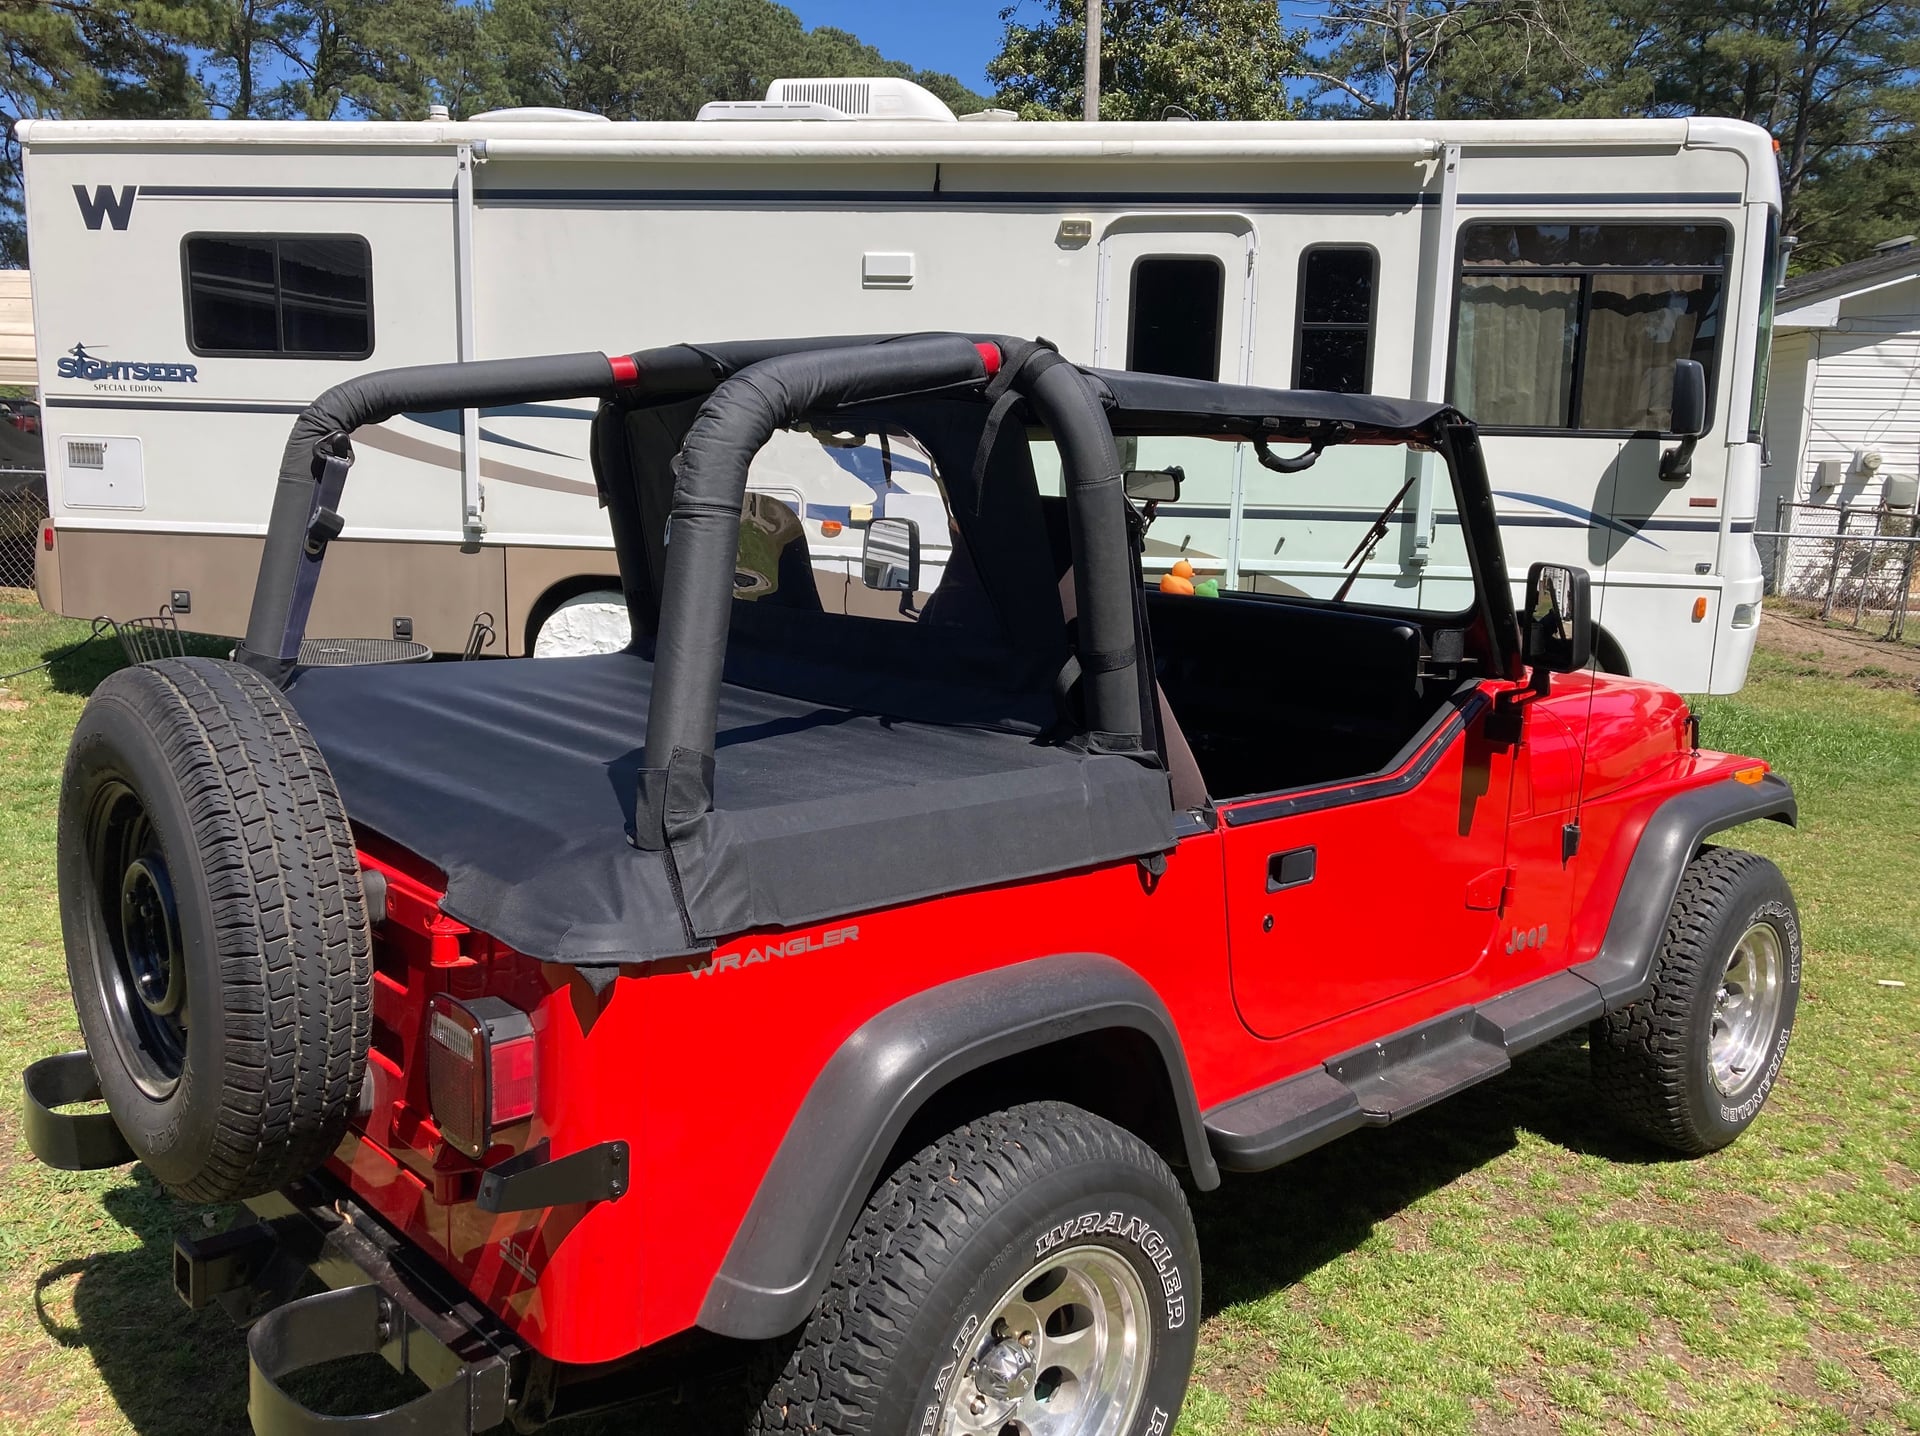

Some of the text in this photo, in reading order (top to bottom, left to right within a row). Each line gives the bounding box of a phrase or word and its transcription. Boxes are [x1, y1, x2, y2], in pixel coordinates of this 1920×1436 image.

[72, 184, 137, 230] W
[57, 354, 198, 383] SIGHTSEER
[94, 383, 163, 393] SPECIAL EDITION
[687, 925, 859, 980] WRANGLER
[1506, 923, 1548, 955] Jeep
[1720, 1028, 1790, 1122] WRANGLER
[1035, 1211, 1186, 1329] WRANGLER
